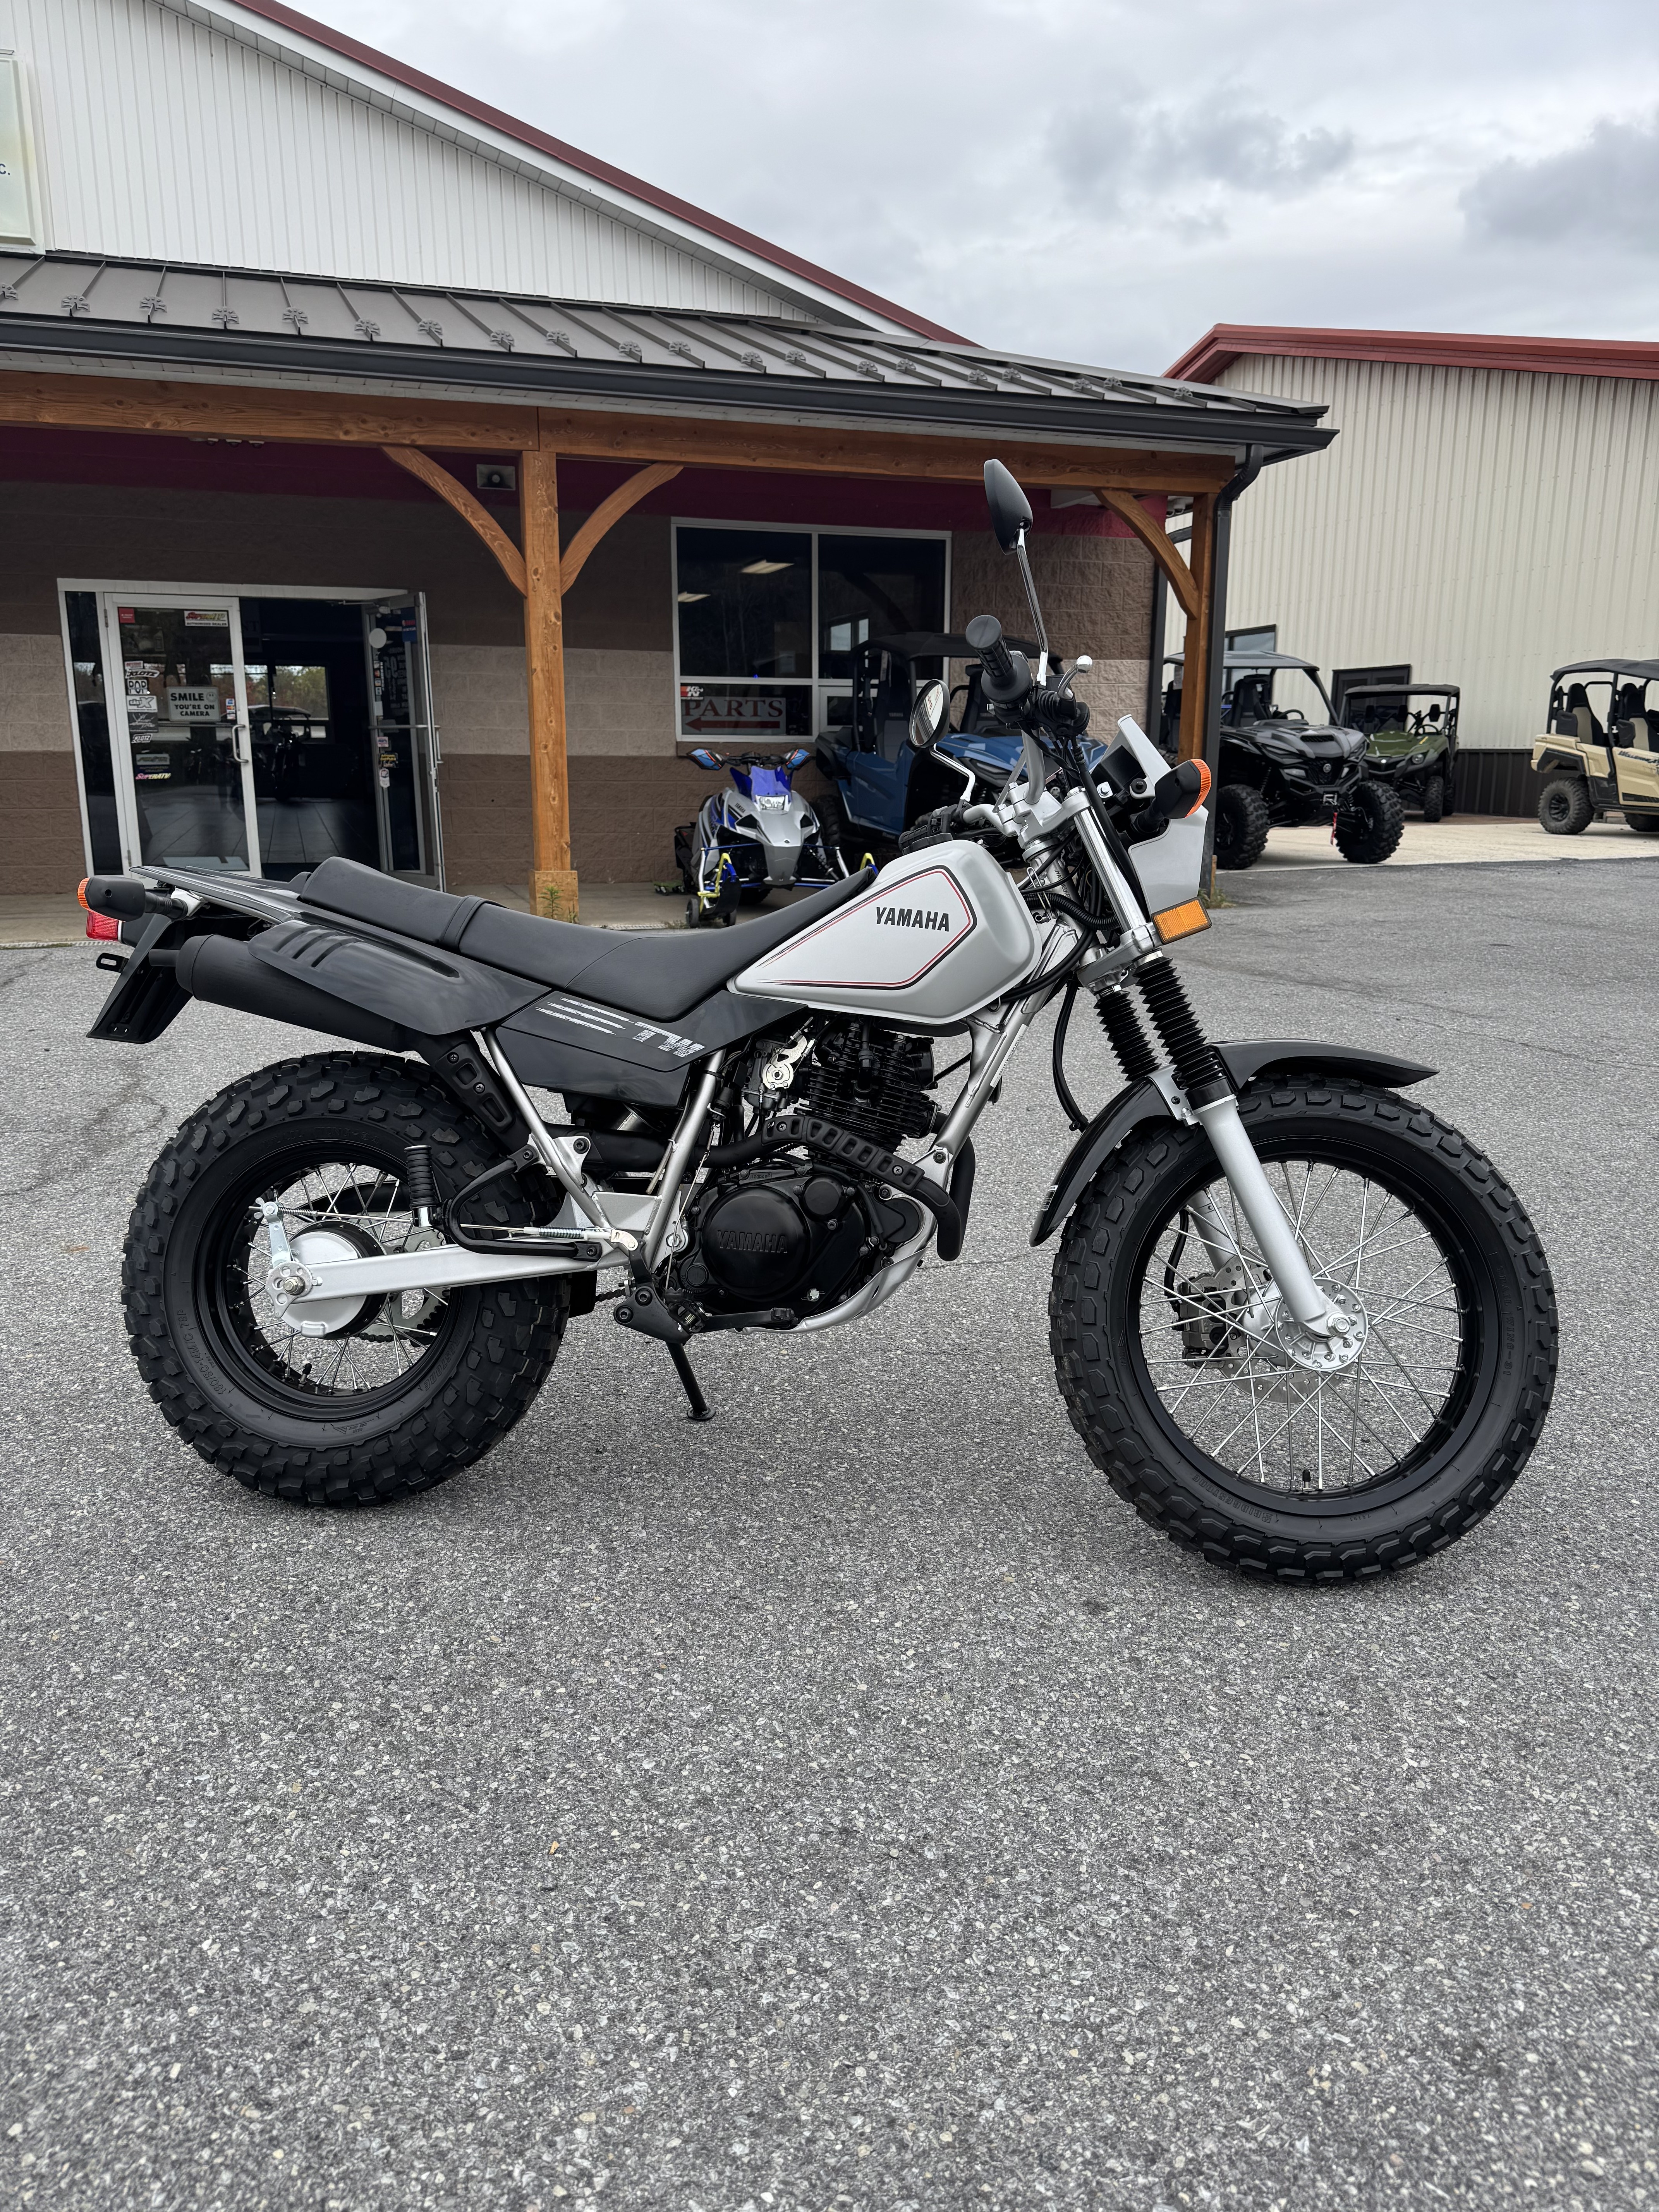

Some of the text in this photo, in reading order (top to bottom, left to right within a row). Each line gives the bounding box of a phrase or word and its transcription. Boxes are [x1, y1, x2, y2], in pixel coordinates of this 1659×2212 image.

[170, 693, 204, 701] SMILE
[682, 698, 783, 717] PARTS
[876, 907, 949, 932] YAMAHA
[717, 1230, 788, 1254] YAMAHA
[1496, 1266, 1512, 1306] TRAIL
[176, 1309, 189, 1329] 78P
[1192, 1474, 1273, 1523] BRIDGESTONE
